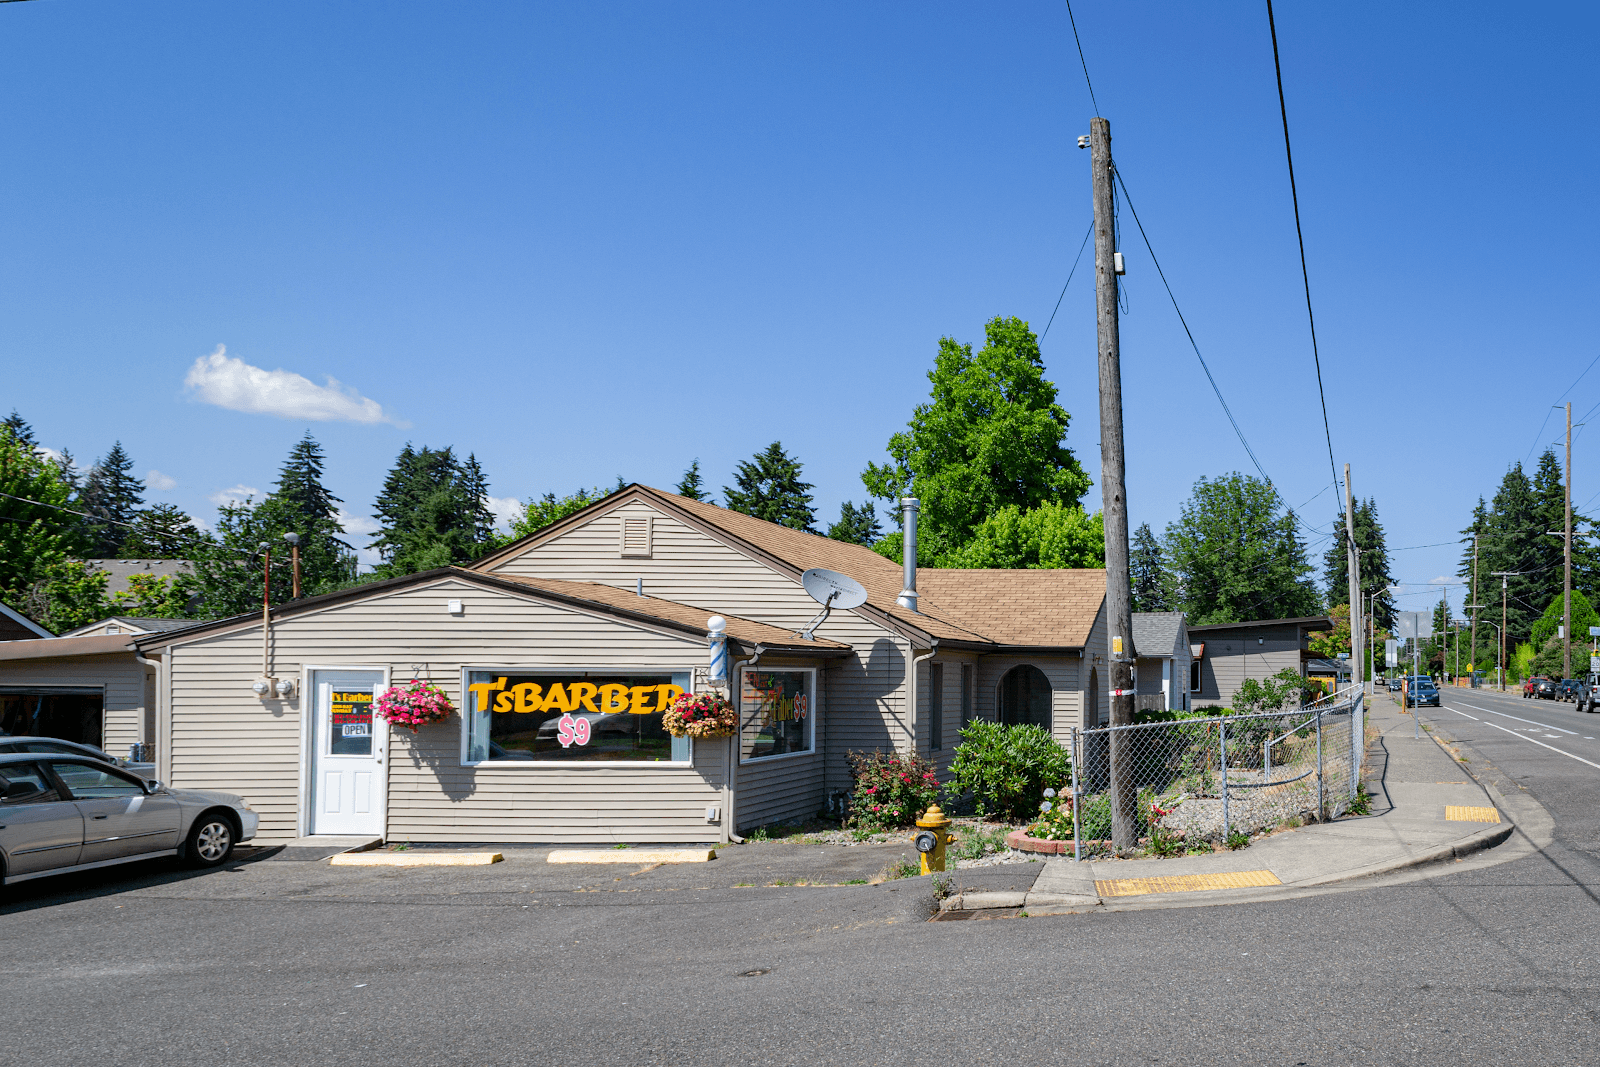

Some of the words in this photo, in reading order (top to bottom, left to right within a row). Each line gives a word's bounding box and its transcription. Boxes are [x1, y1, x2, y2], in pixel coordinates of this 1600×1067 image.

[511, 682, 684, 714] BARBER
[793, 691, 807, 722] $9
[344, 725, 366, 735] OPEN
[557, 712, 591, 748] $9
